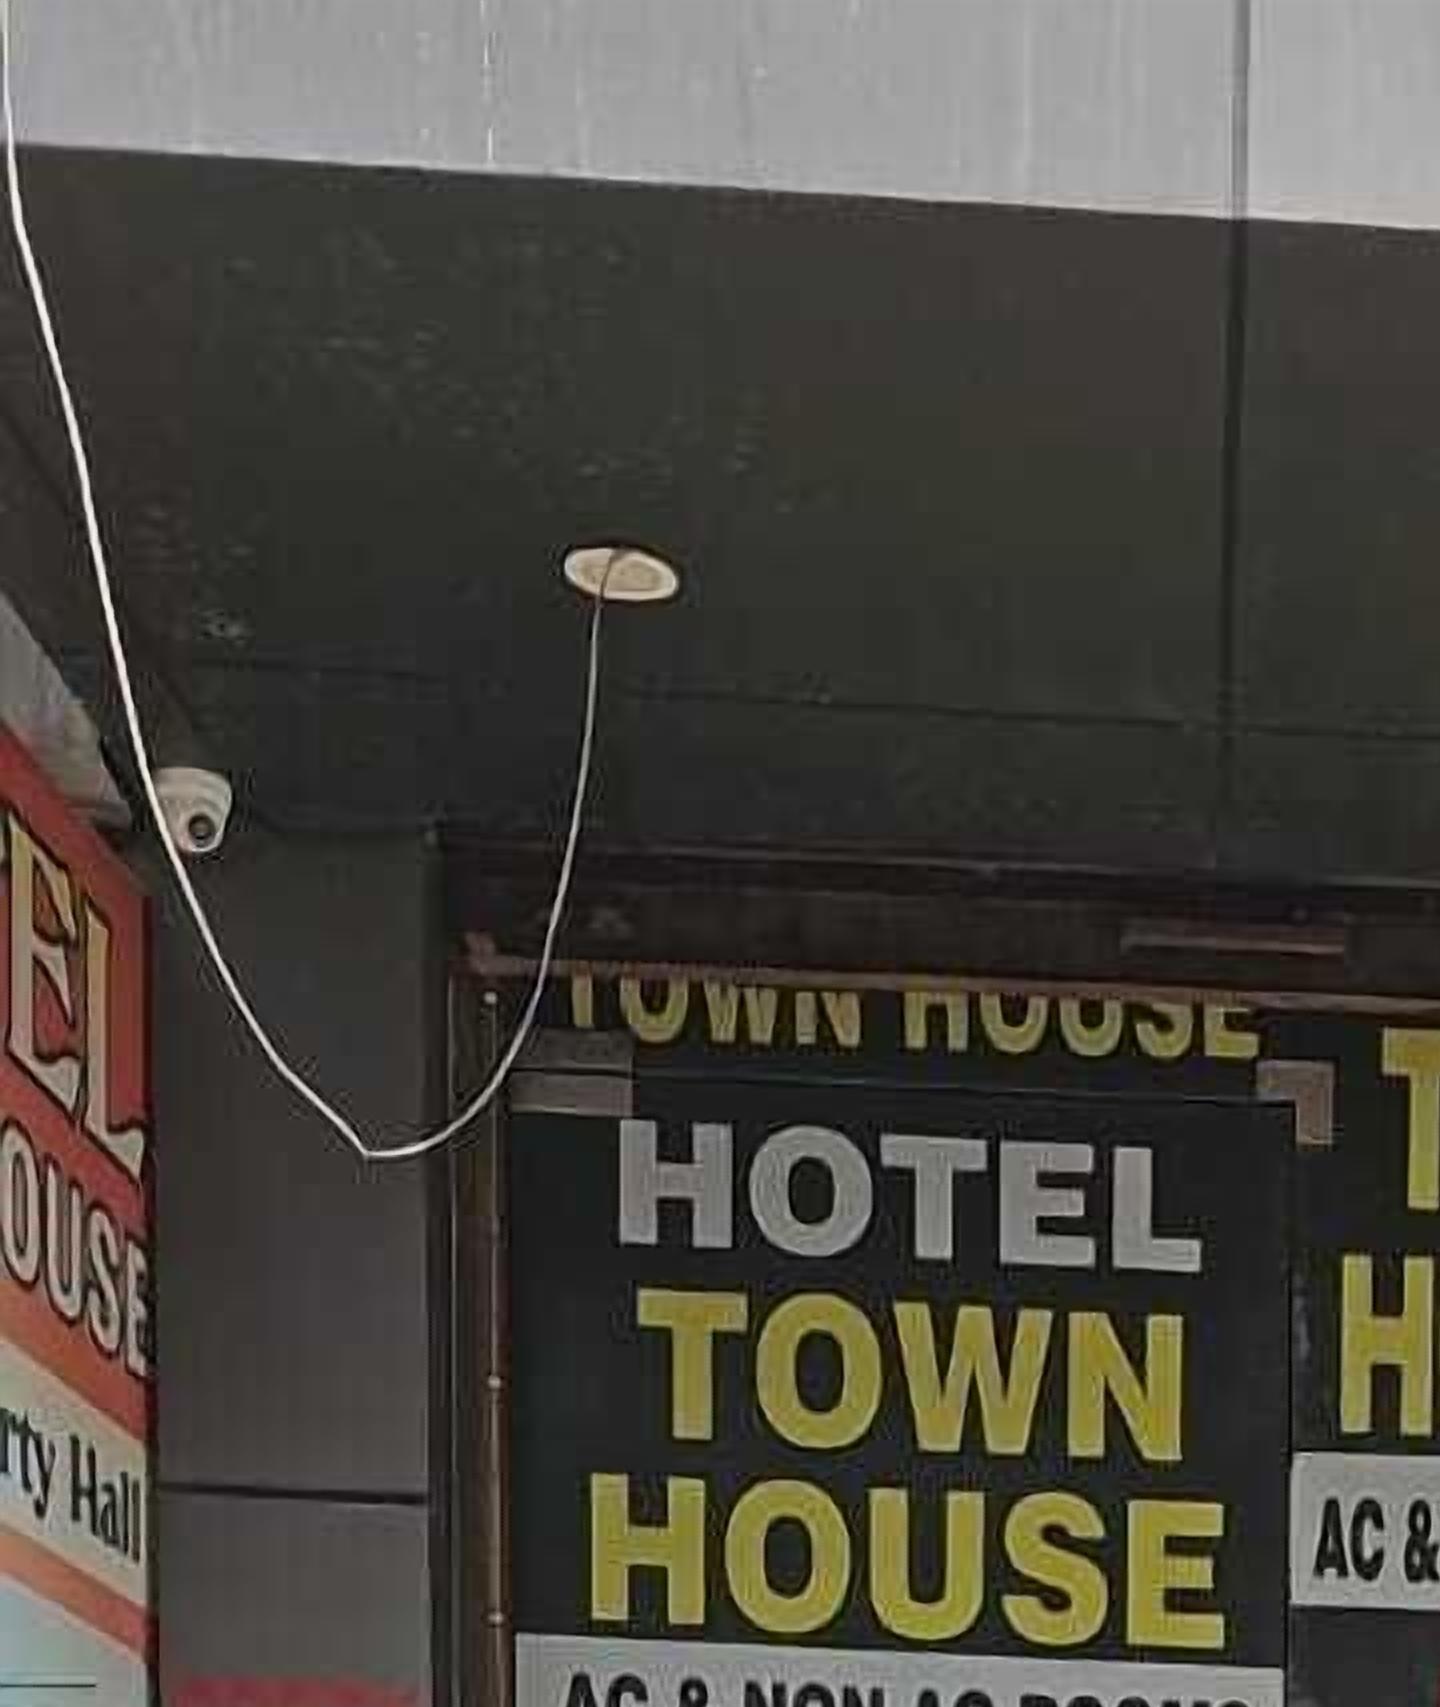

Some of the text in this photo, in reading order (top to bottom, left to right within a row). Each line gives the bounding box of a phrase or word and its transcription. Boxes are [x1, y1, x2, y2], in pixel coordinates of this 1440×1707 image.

[0, 812, 146, 1182] EL
[617, 1118, 1201, 1273] HOTEL
[636, 1287, 1183, 1461] TOWN
[70, 1433, 141, 1564] Hall
[589, 1472, 1226, 1650] HOUSE
[1314, 1498, 1386, 1582] AC
[1404, 1500, 1440, 1585] &
